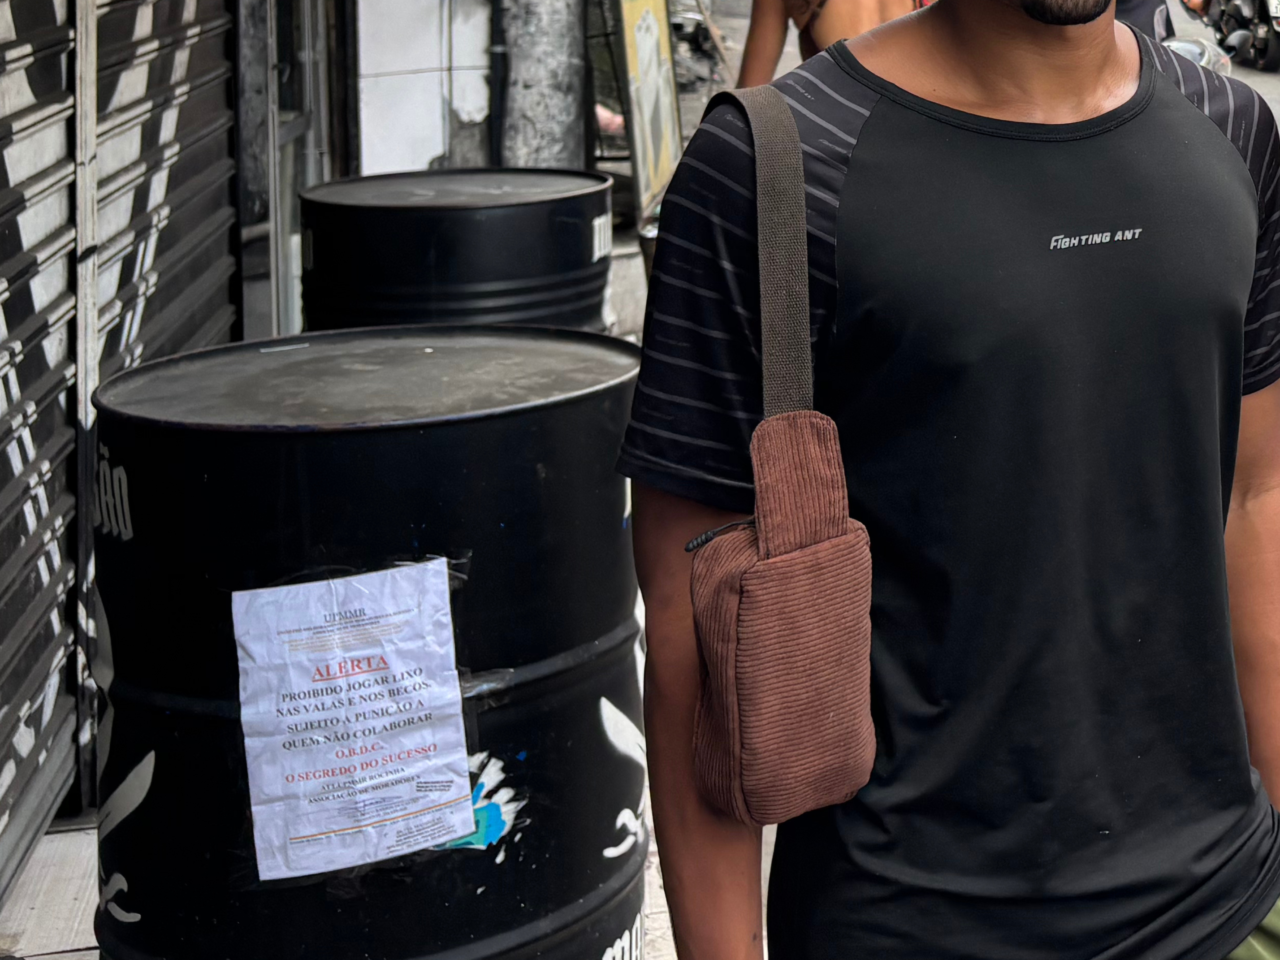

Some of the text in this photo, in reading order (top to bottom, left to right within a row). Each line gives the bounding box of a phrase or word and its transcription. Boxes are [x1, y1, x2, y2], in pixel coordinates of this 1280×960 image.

[1050, 228, 1142, 250] FIGHTING ANT
[323, 607, 367, 623] UPMMR
[312, 655, 389, 681] ALERTA
[281, 666, 423, 702] PROIBIDO JOGAR LIXO
[276, 706, 301, 718] NAS
[303, 698, 345, 713] VALAS
[348, 697, 356, 707] E
[359, 690, 385, 704] NOS
[286, 716, 340, 734] SUJEITO
[355, 700, 413, 722] PUNIÇÃO
[416, 699, 425, 708] A
[282, 712, 433, 751] QUEM NÃO COLABORAR
[285, 743, 438, 783] O SEGREDO DO SUCESSO
[335, 741, 384, 759] O.B.D.C.
[369, 766, 406, 782] ROCINHA
[308, 790, 358, 805] ASSOCIAÇÃO
[359, 786, 370, 796] DE
[371, 774, 422, 793] MORADORES
